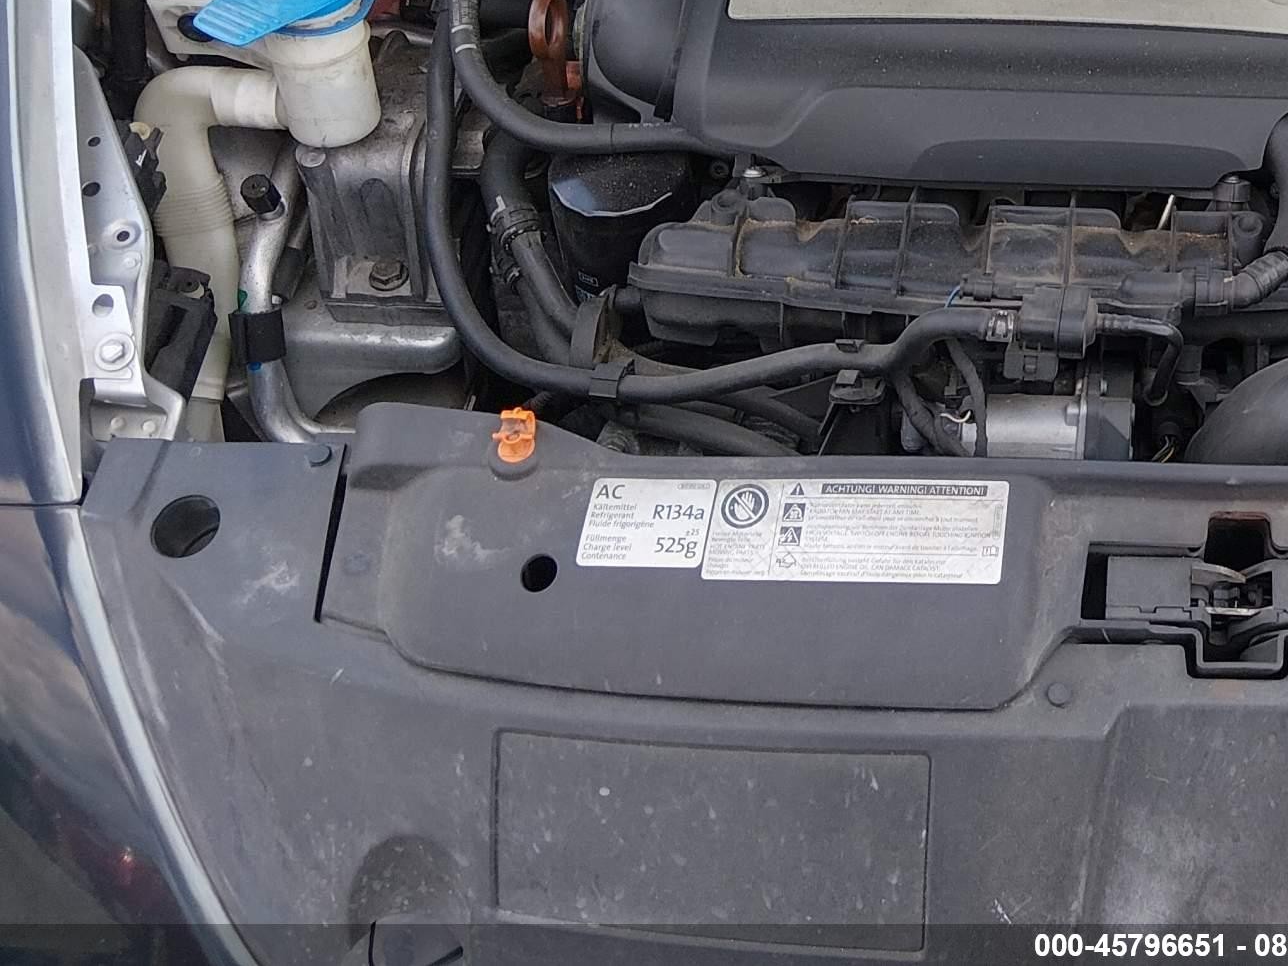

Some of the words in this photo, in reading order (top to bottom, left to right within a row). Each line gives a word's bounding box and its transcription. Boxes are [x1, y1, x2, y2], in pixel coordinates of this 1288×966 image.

[596, 484, 625, 499] AC
[825, 485, 876, 494] ACHTUNG!
[878, 485, 927, 495] WARNING!
[929, 486, 985, 495] ATTENTION!
[593, 503, 637, 511] Kältemittel
[652, 504, 706, 520] R134a
[590, 511, 634, 520] Refrigerant
[588, 520, 612, 528] Fluide
[586, 534, 627, 544] Füllmenge
[584, 542, 612, 552] Charge
[613, 542, 633, 551] level
[654, 537, 698, 559] 525g
[581, 552, 626, 560] Contenance
